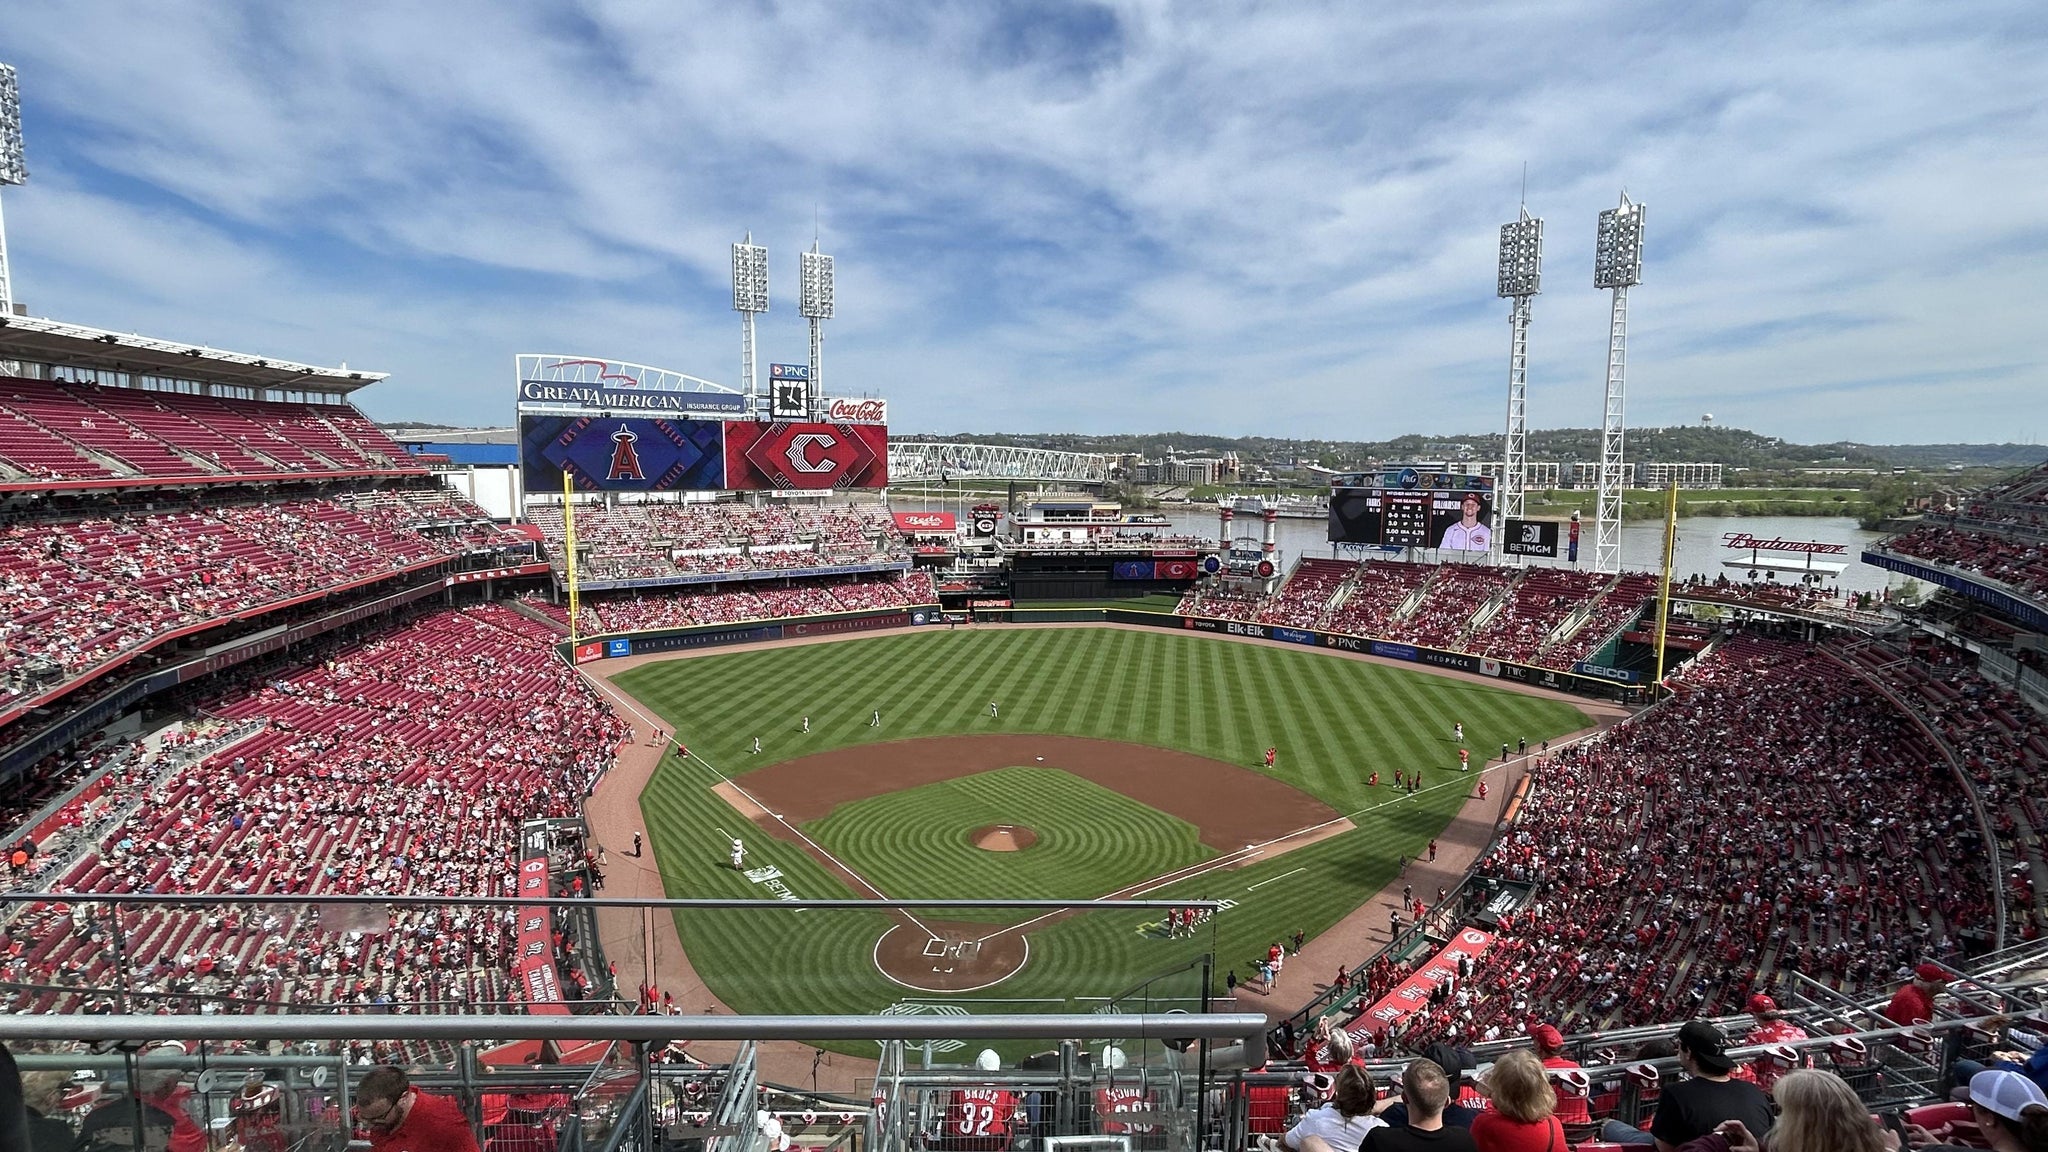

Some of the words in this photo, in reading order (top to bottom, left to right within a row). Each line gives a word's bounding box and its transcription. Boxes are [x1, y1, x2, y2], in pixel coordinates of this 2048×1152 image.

[784, 366, 808, 377] PNC
[524, 382, 593, 401] GREAT
[687, 403, 720, 411] INSURANCE
[721, 404, 742, 412] GROUP
[829, 400, 885, 421] Coca-Cola
[1401, 475, 1417, 483] P&G
[905, 515, 943, 525] Reds
[1510, 543, 1551, 554] BETMGM
[1890, 561, 1918, 577] ANGELES
[821, 620, 875, 631] CINCINNATI
[638, 641, 657, 649] LOS
[664, 636, 707, 647] ANGELES
[1338, 637, 1360, 650] PNC
[205, 641, 274, 672] CINCINNATI
[282, 630, 304, 646] REDS
[1426, 654, 1469, 667] MEDPACE
[1486, 663, 1495, 671] W
[1505, 665, 1527, 678] TWC
[1582, 663, 1629, 680] GEICO
[964, 1089, 999, 1104] BRUCE
[960, 1102, 994, 1136] 32
